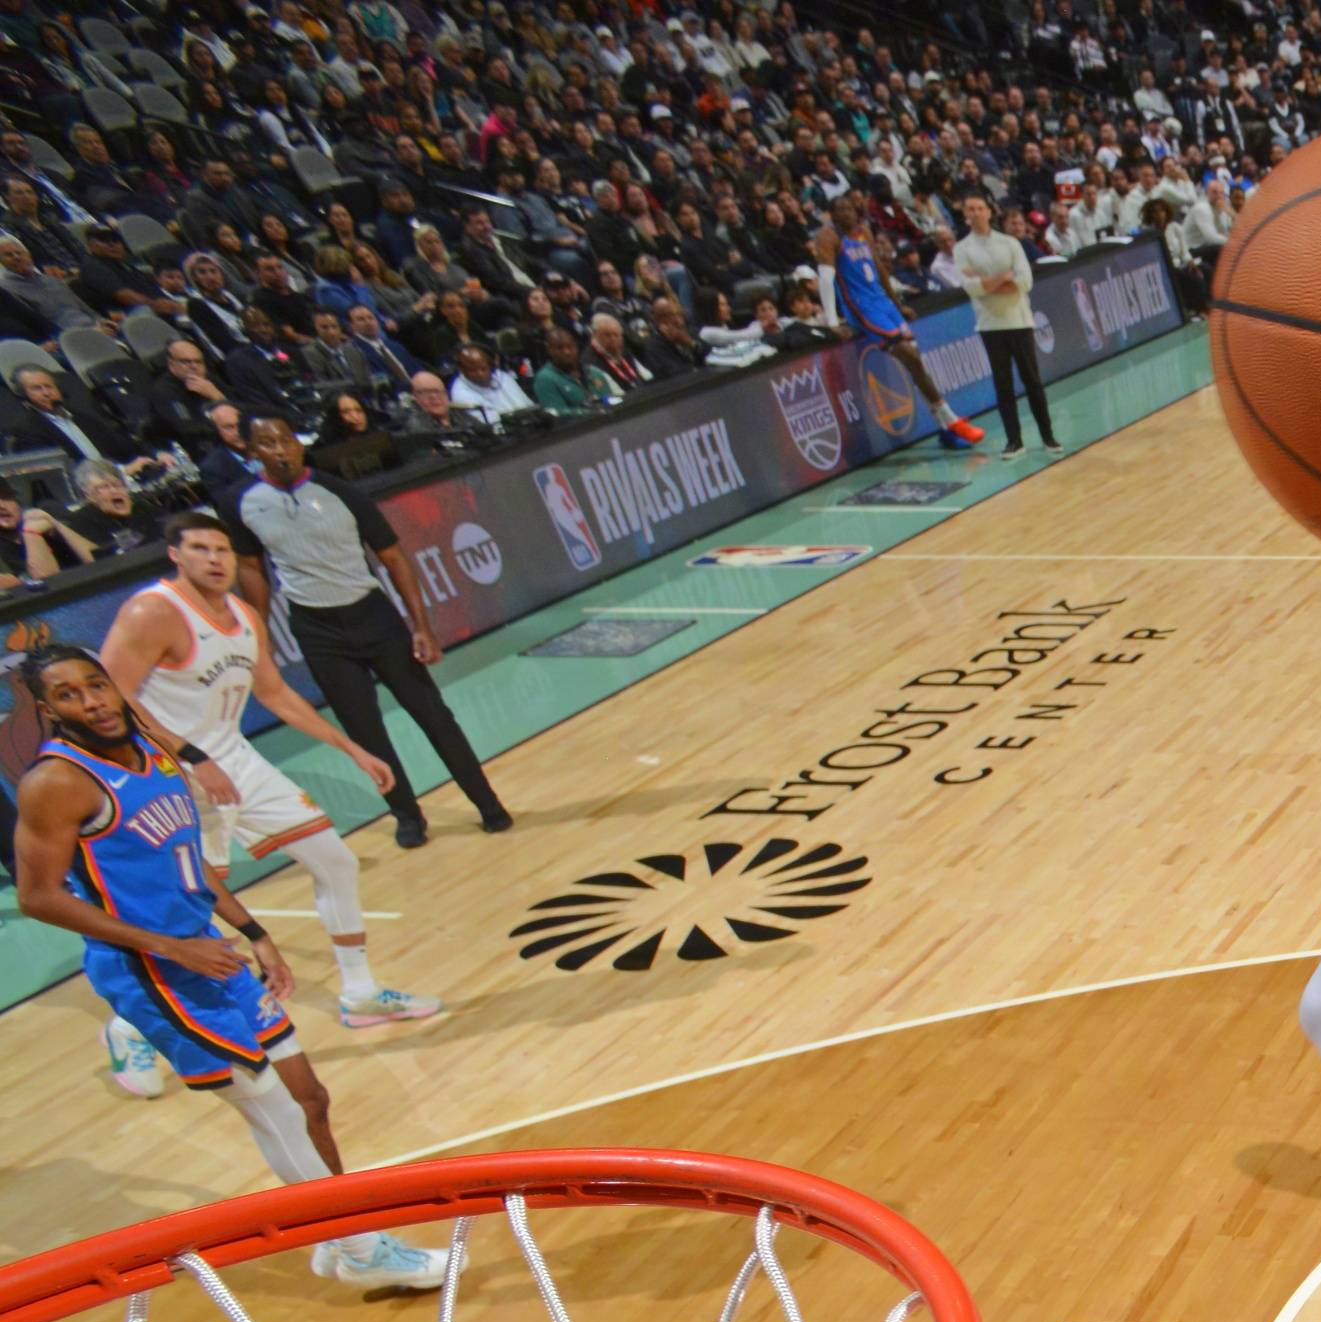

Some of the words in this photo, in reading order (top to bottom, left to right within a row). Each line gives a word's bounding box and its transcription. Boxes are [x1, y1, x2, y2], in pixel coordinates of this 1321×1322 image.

[922, 333, 994, 394] OMORROW
[788, 405, 836, 439] KINGS
[579, 437, 684, 544] RIVALS
[664, 418, 747, 508] WEEK
[454, 538, 500, 575] TNT
[698, 701, 979, 822] Frost
[900, 597, 1129, 692] Bank
[933, 627, 1179, 785] CENTER
[125, 792, 194, 848] THUND
[174, 842, 203, 892] 1
